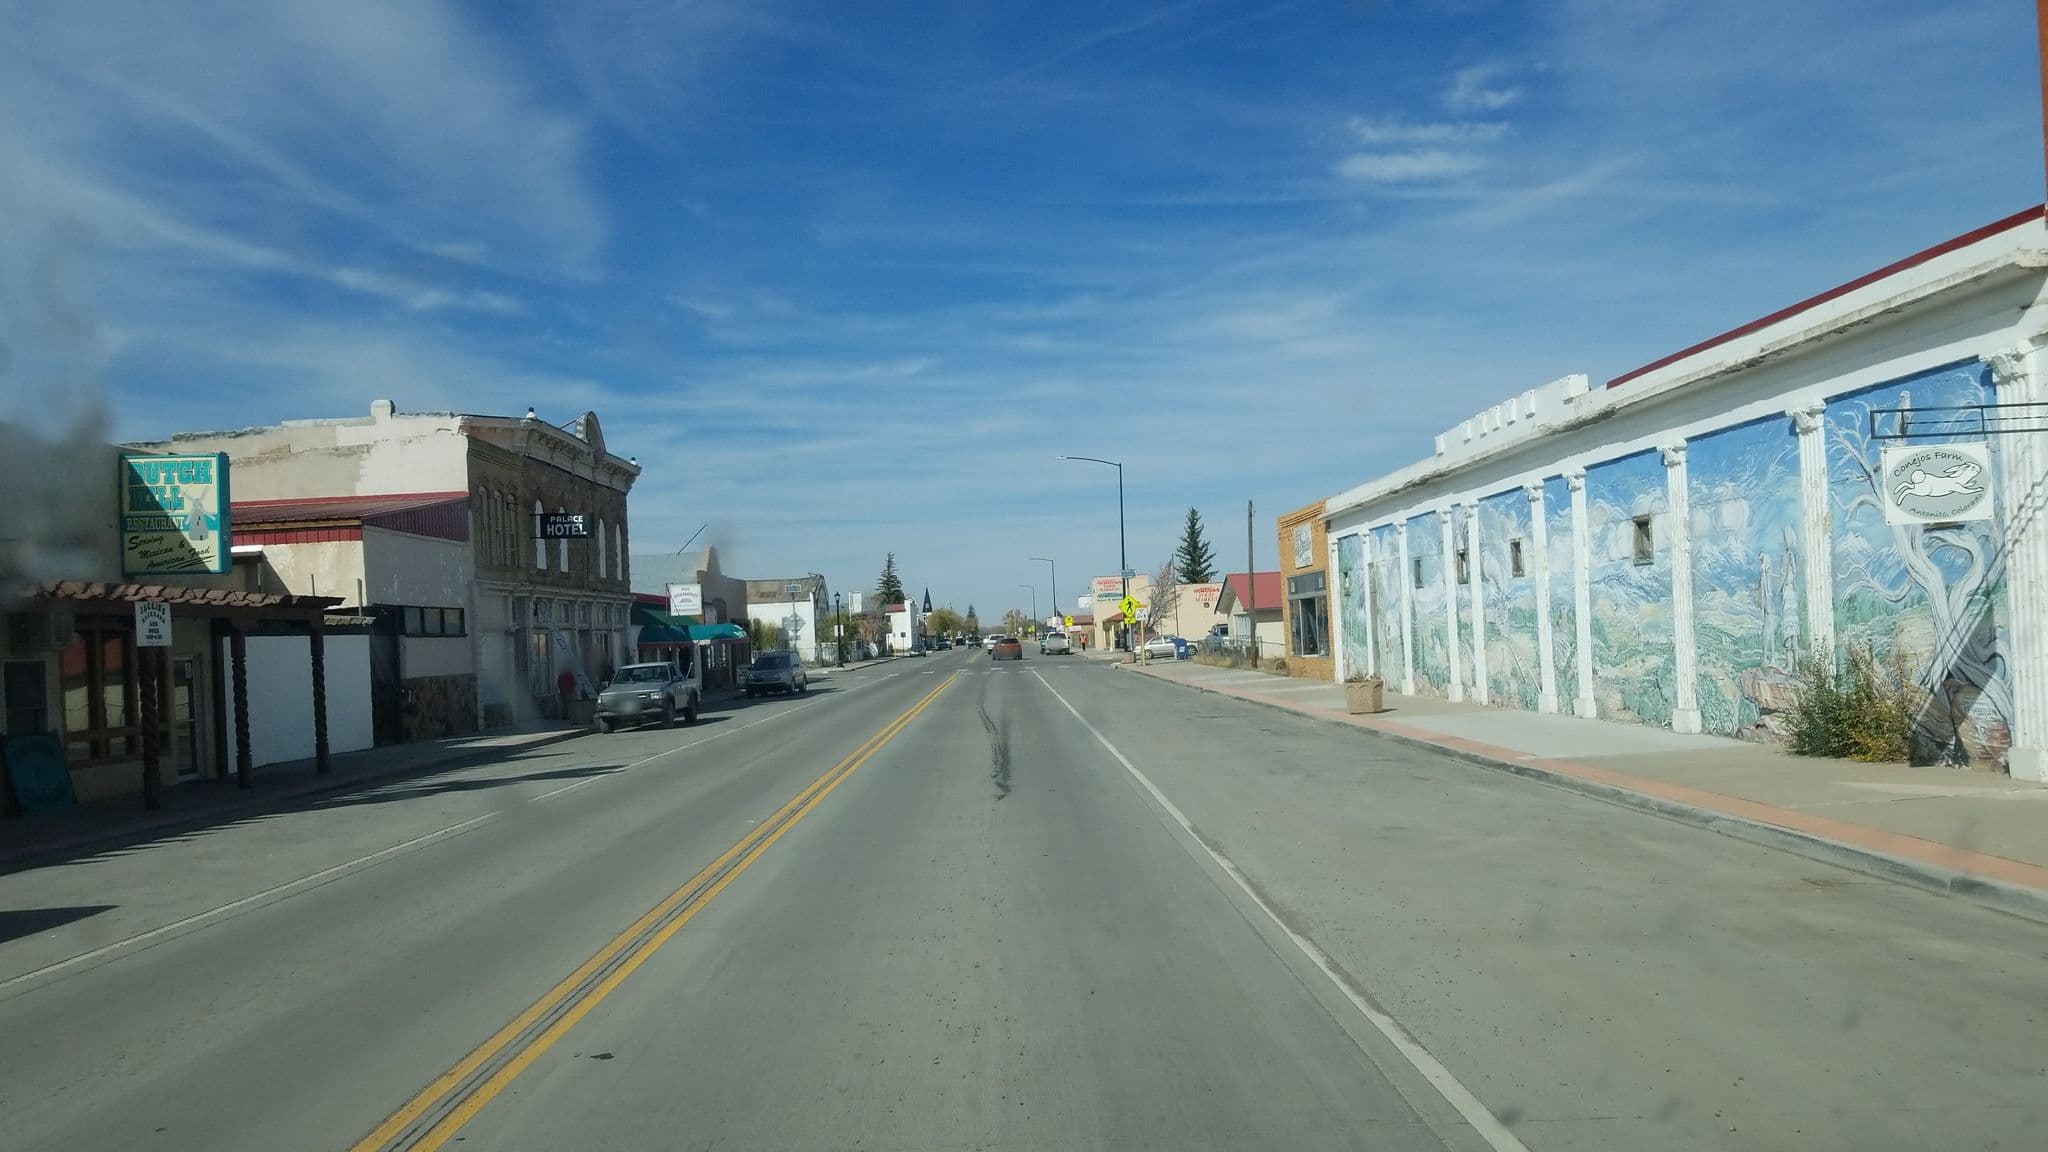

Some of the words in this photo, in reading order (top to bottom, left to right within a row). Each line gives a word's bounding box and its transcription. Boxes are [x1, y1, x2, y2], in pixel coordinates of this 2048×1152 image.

[1894, 452, 1931, 477] Conejos
[1935, 451, 1964, 462] Farm
[128, 460, 212, 485] DUTCH
[1951, 493, 1984, 515] Colorado
[127, 516, 185, 531] RESTAURANT
[550, 515, 584, 523] PALACE
[546, 523, 588, 536] HOTEL
[128, 536, 164, 551] Serving
[140, 547, 173, 559] Mexican
[147, 556, 186, 570] American
[189, 546, 210, 559] Food
